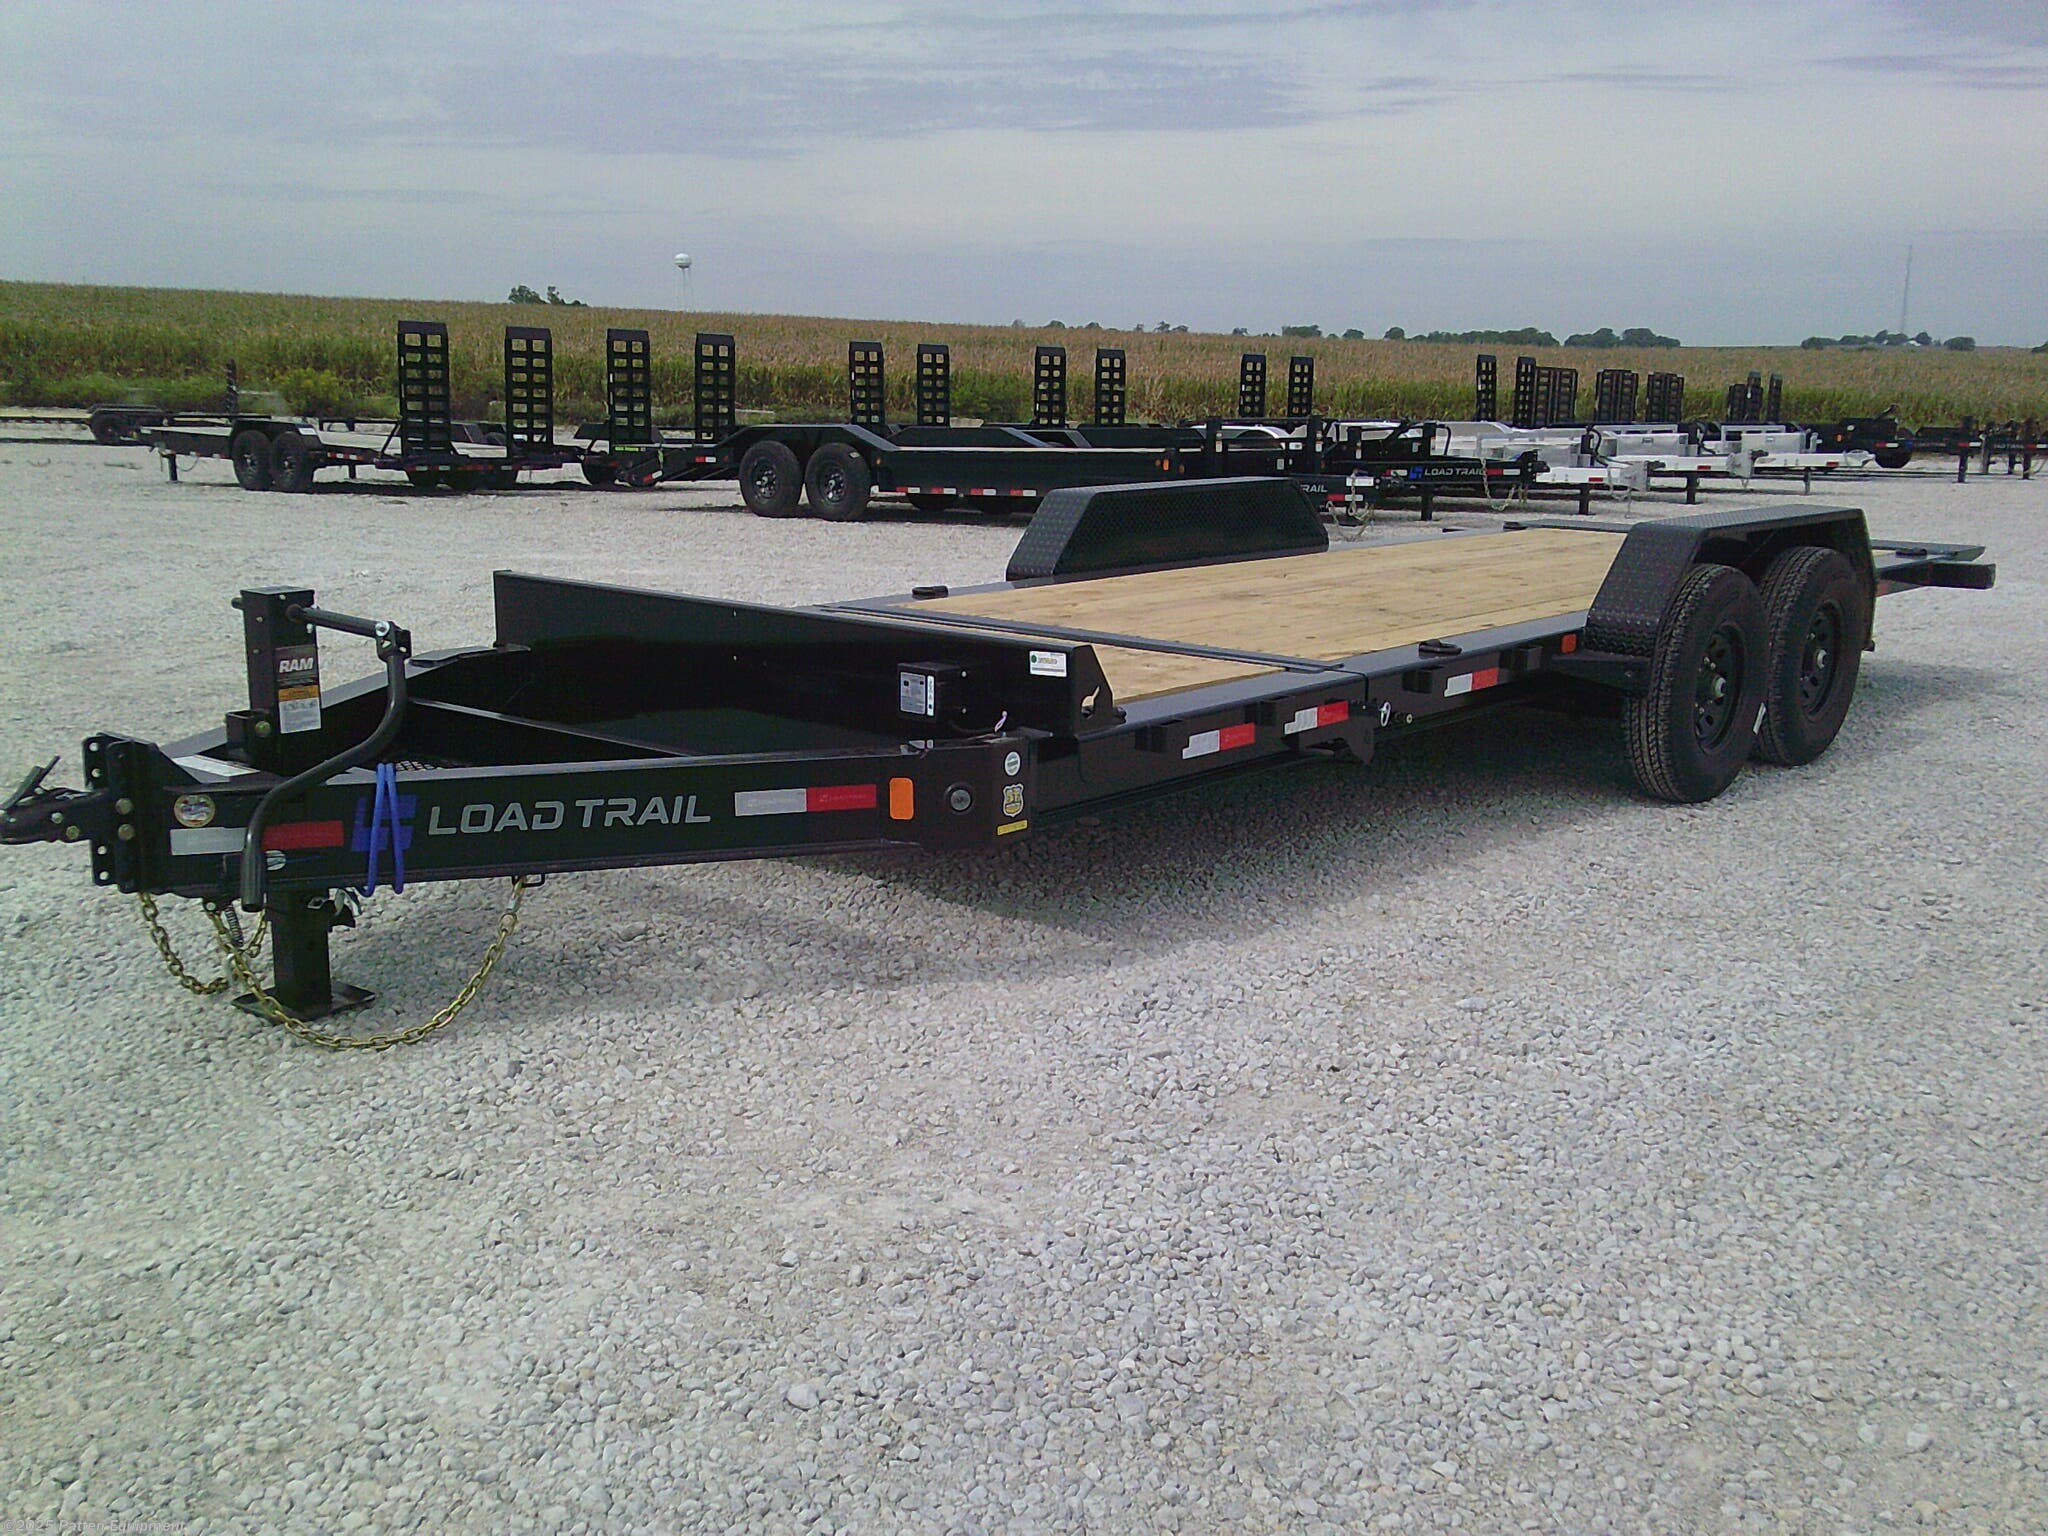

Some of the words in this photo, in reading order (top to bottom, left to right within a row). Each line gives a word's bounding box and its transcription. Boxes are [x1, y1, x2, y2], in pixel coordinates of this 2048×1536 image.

[1424, 467, 1454, 476] LOAD
[1300, 484, 1329, 493] RAIL
[279, 657, 314, 673] RAM
[428, 801, 564, 835] LOAD
[576, 795, 711, 828] TRAIL
